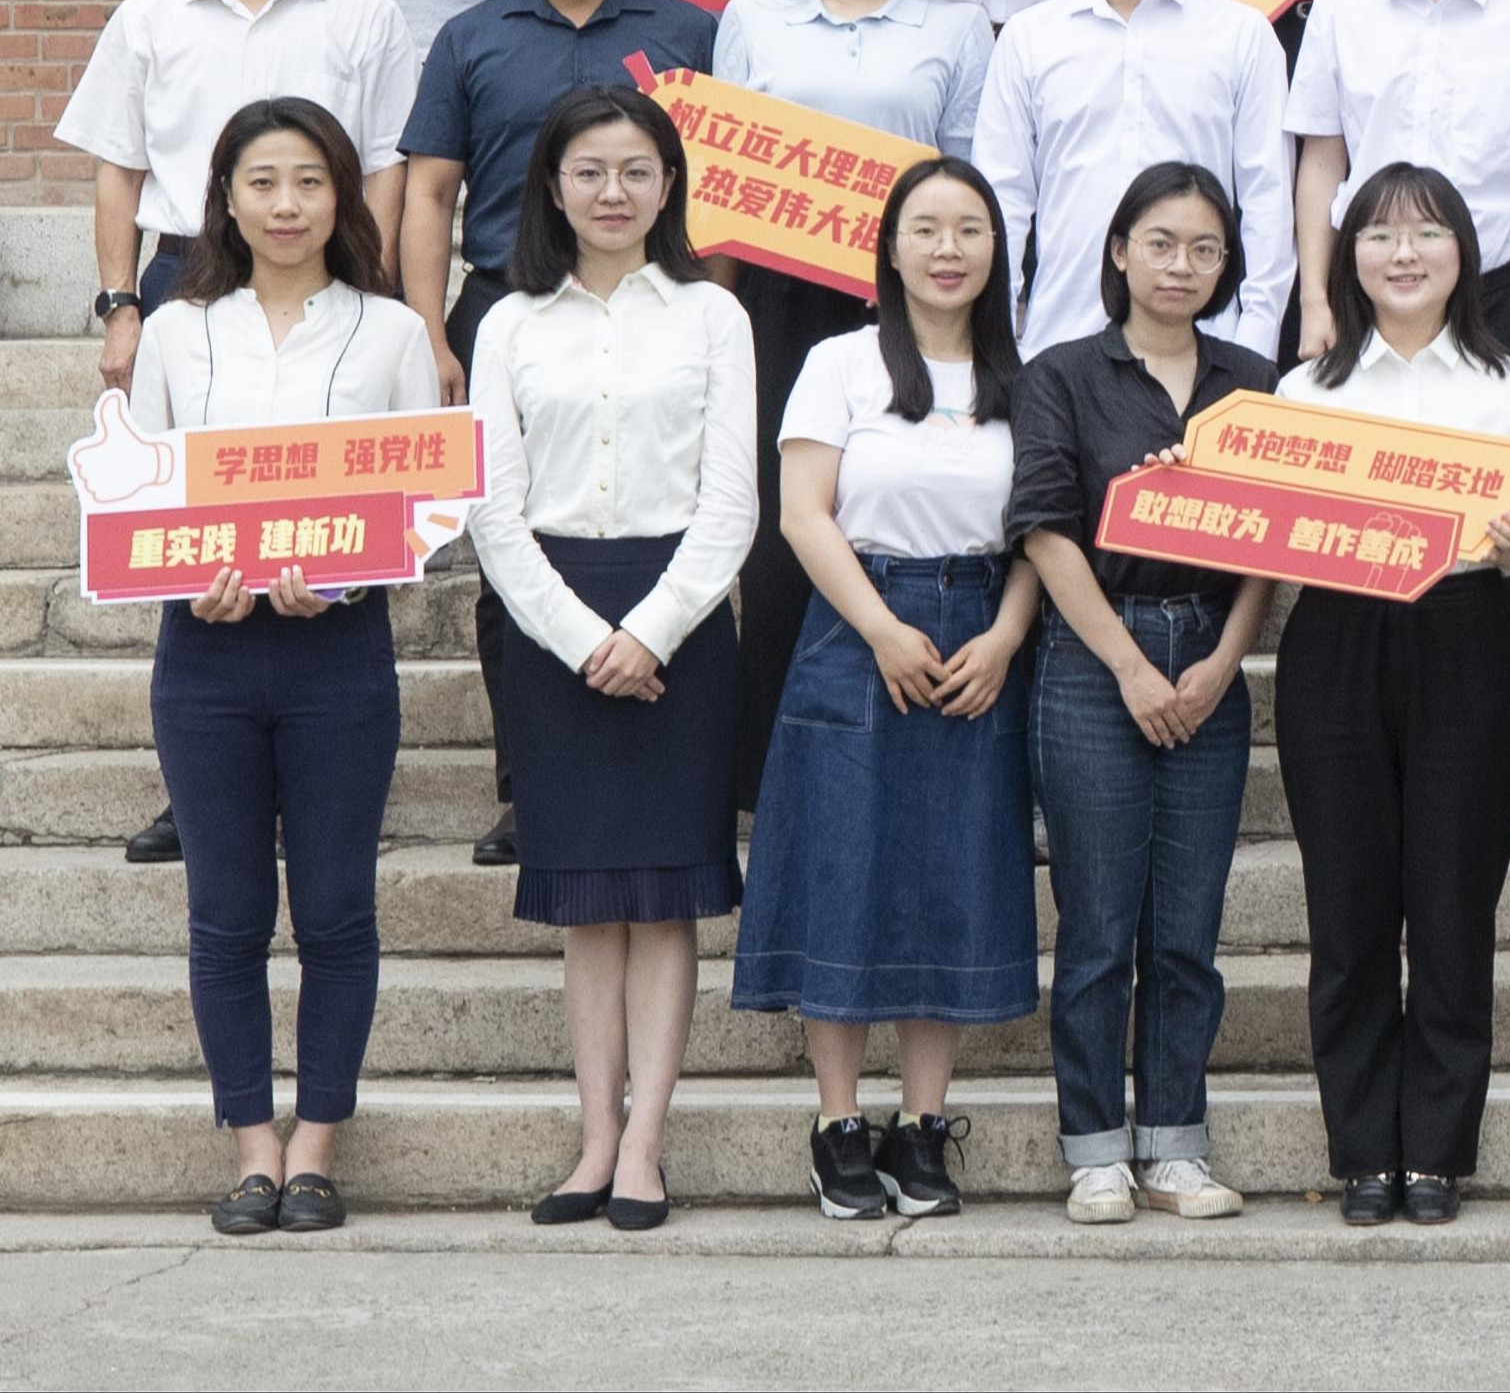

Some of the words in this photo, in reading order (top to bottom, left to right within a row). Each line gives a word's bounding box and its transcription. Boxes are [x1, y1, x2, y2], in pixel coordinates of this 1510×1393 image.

[667, 97, 898, 201] 树立远大理想
[213, 442, 319, 486] 学思想
[344, 431, 447, 477] 强党性
[1216, 423, 1354, 475] 怀抱梦想
[1367, 450, 1505, 500] 脚踏实地
[127, 521, 238, 570] 重实践
[258, 513, 367, 561] 建新功
[1129, 488, 1270, 544] 敢想敢为
[1287, 515, 1430, 572] 善作善成
